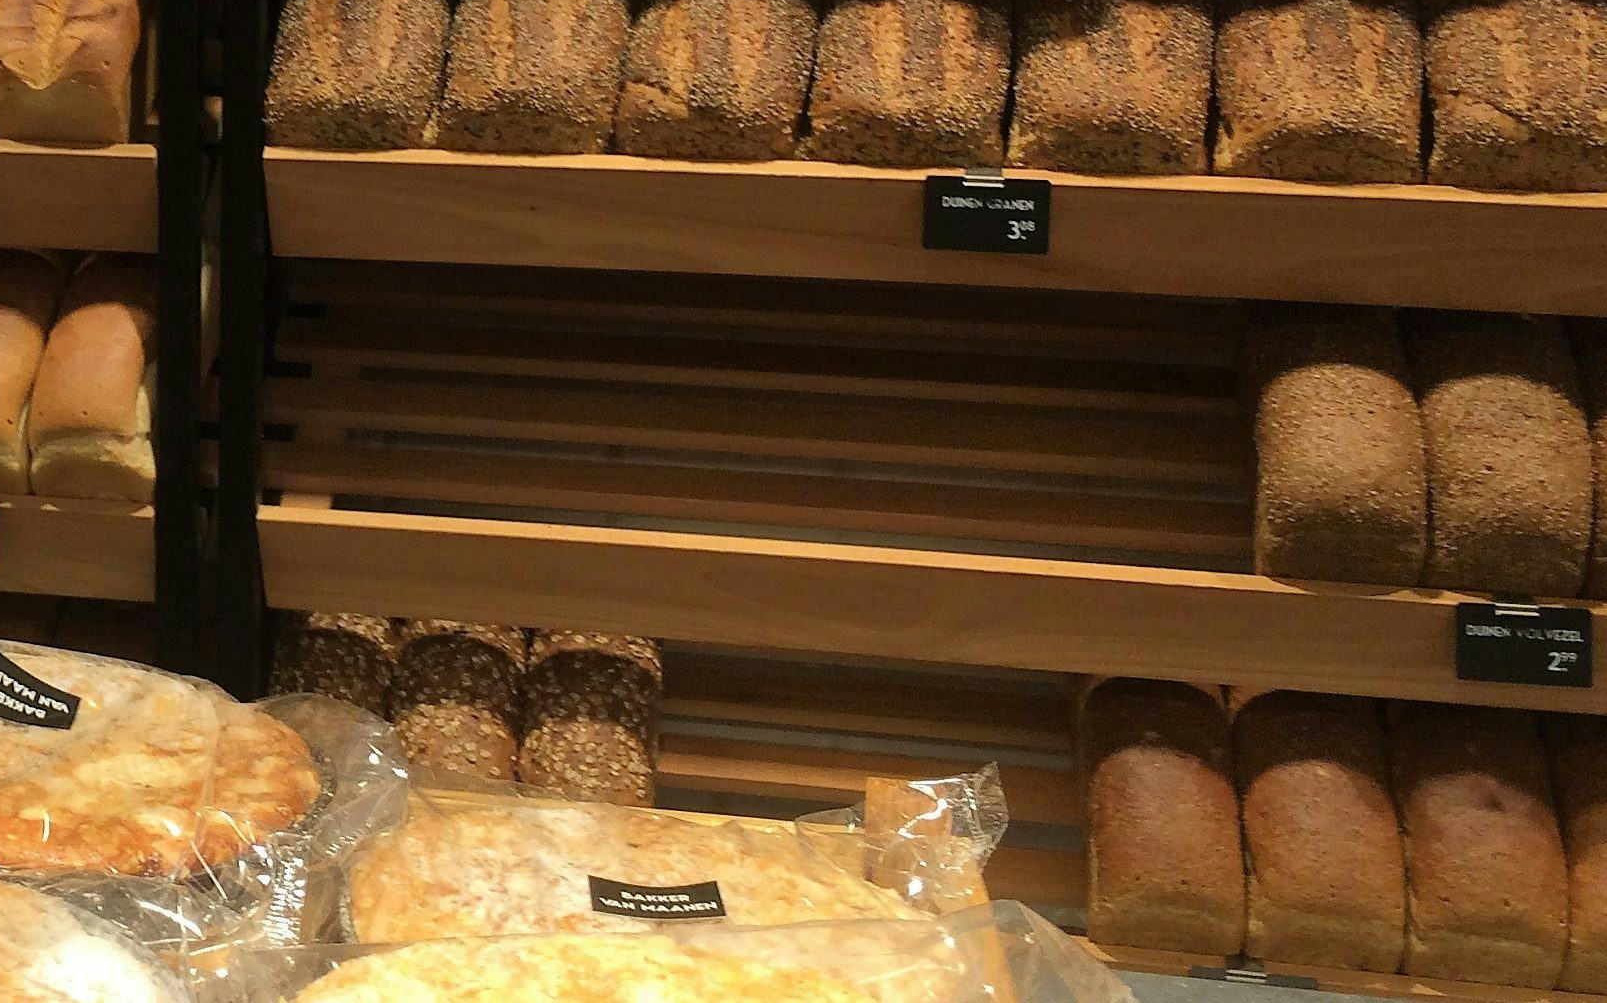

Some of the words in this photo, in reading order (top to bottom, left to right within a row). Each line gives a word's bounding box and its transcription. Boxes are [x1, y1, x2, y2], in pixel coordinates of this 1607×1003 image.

[37, 694, 70, 714] VAN
[598, 896, 636, 911] VAN
[640, 900, 719, 913] MAANEN
[619, 890, 691, 903] BAKKER
